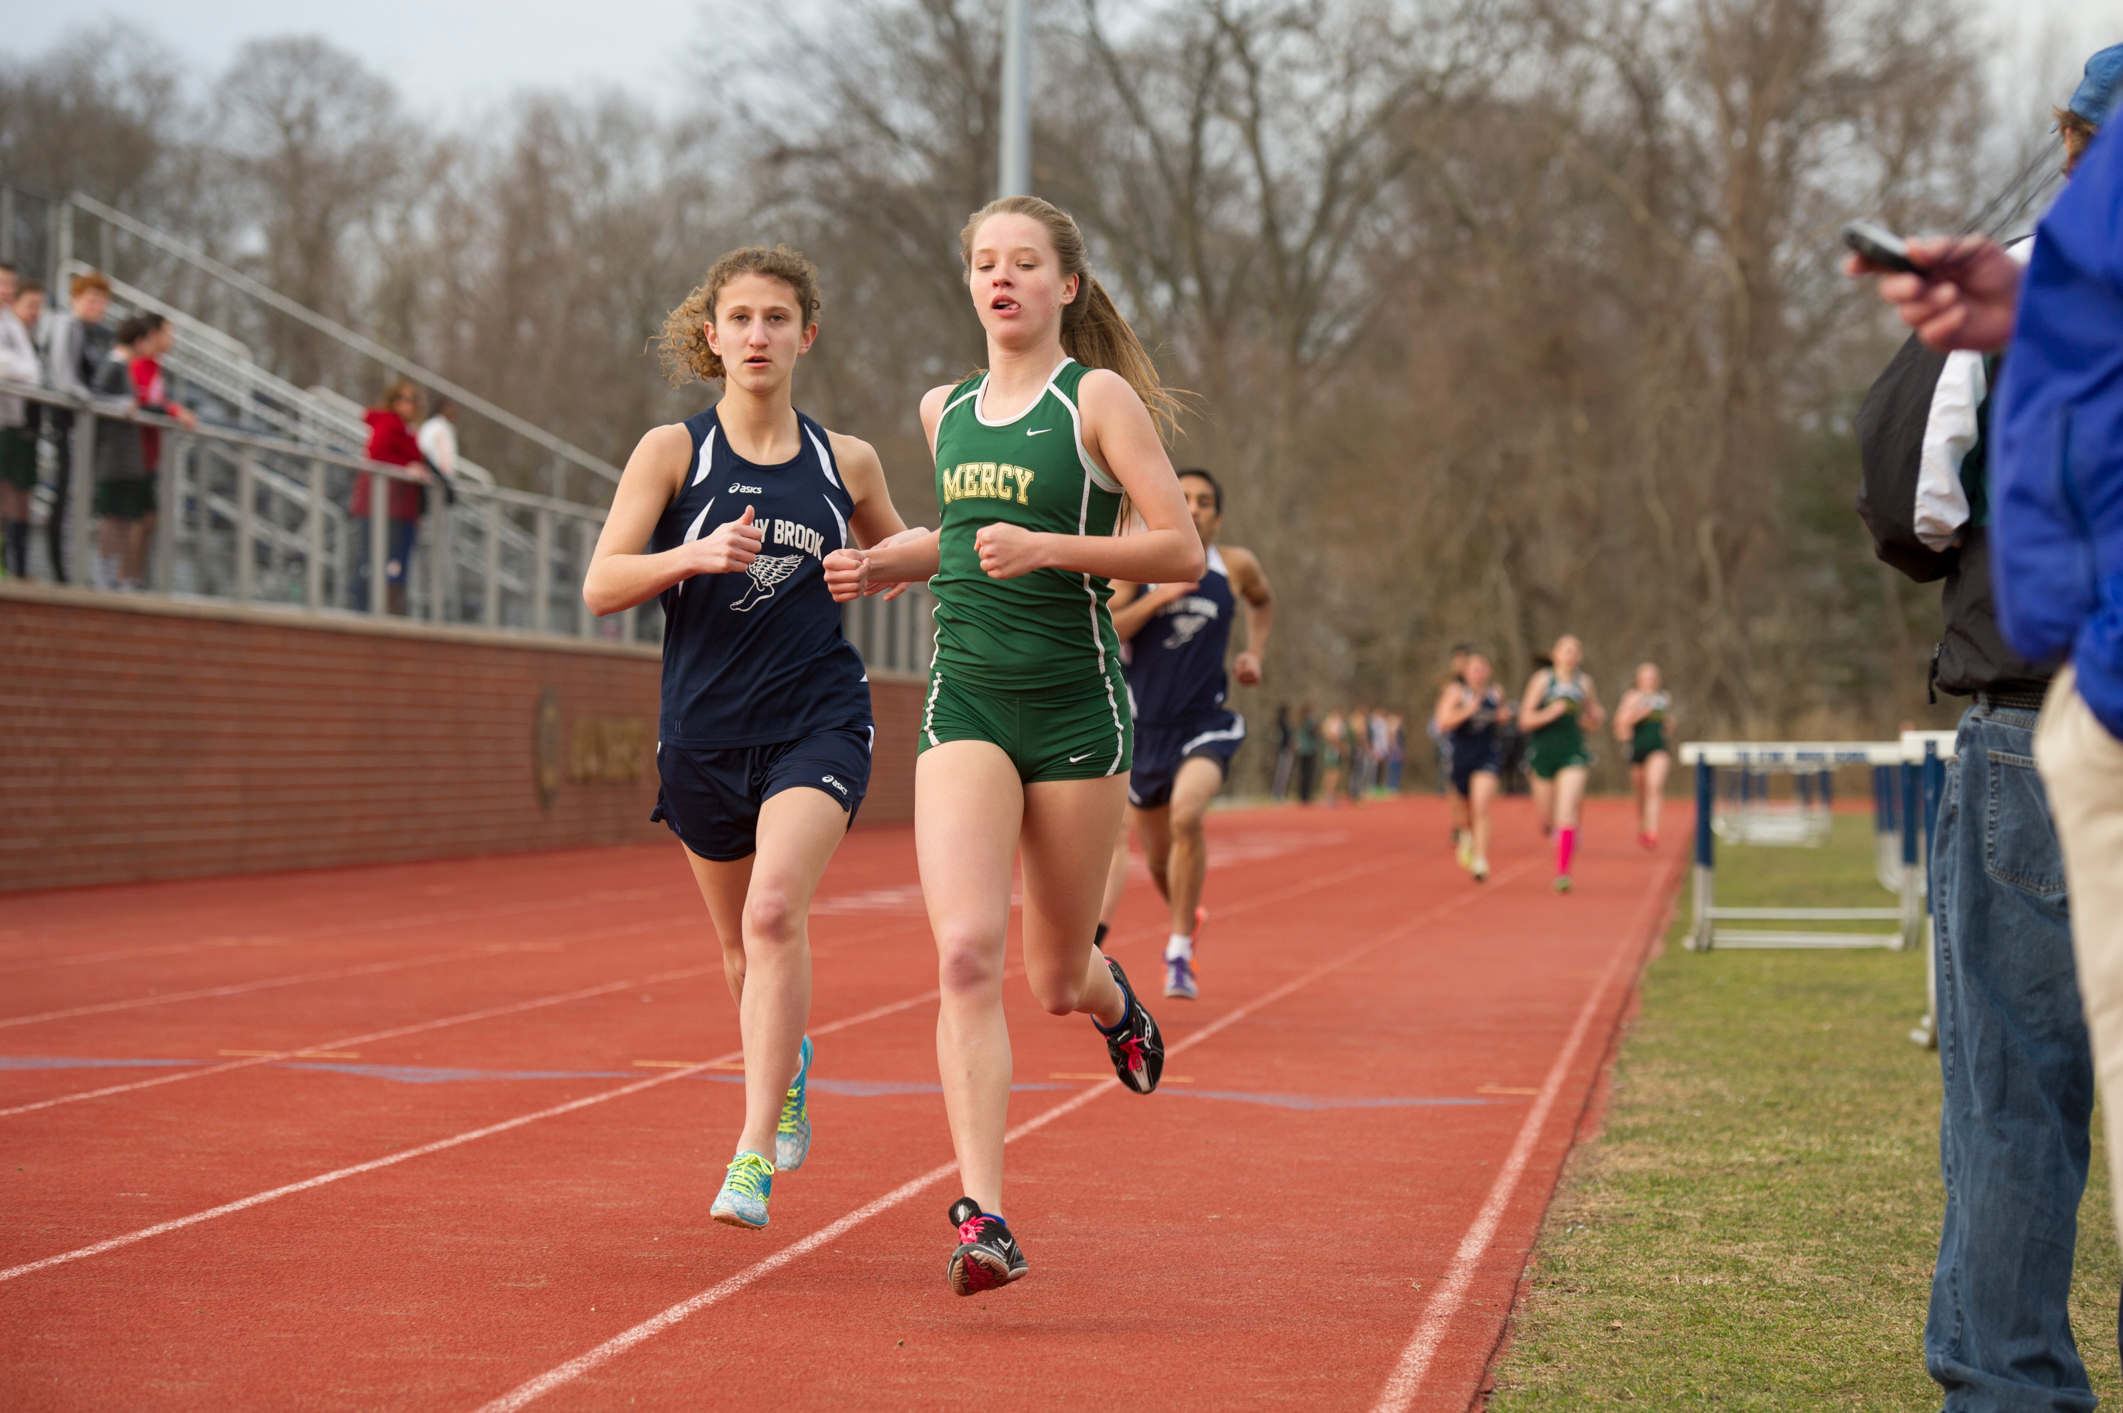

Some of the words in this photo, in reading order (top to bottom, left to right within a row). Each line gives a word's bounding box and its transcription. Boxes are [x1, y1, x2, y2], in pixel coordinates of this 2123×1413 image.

[739, 485, 762, 494] asics
[942, 462, 1035, 506] MERCY
[773, 518, 824, 561] BROOK
